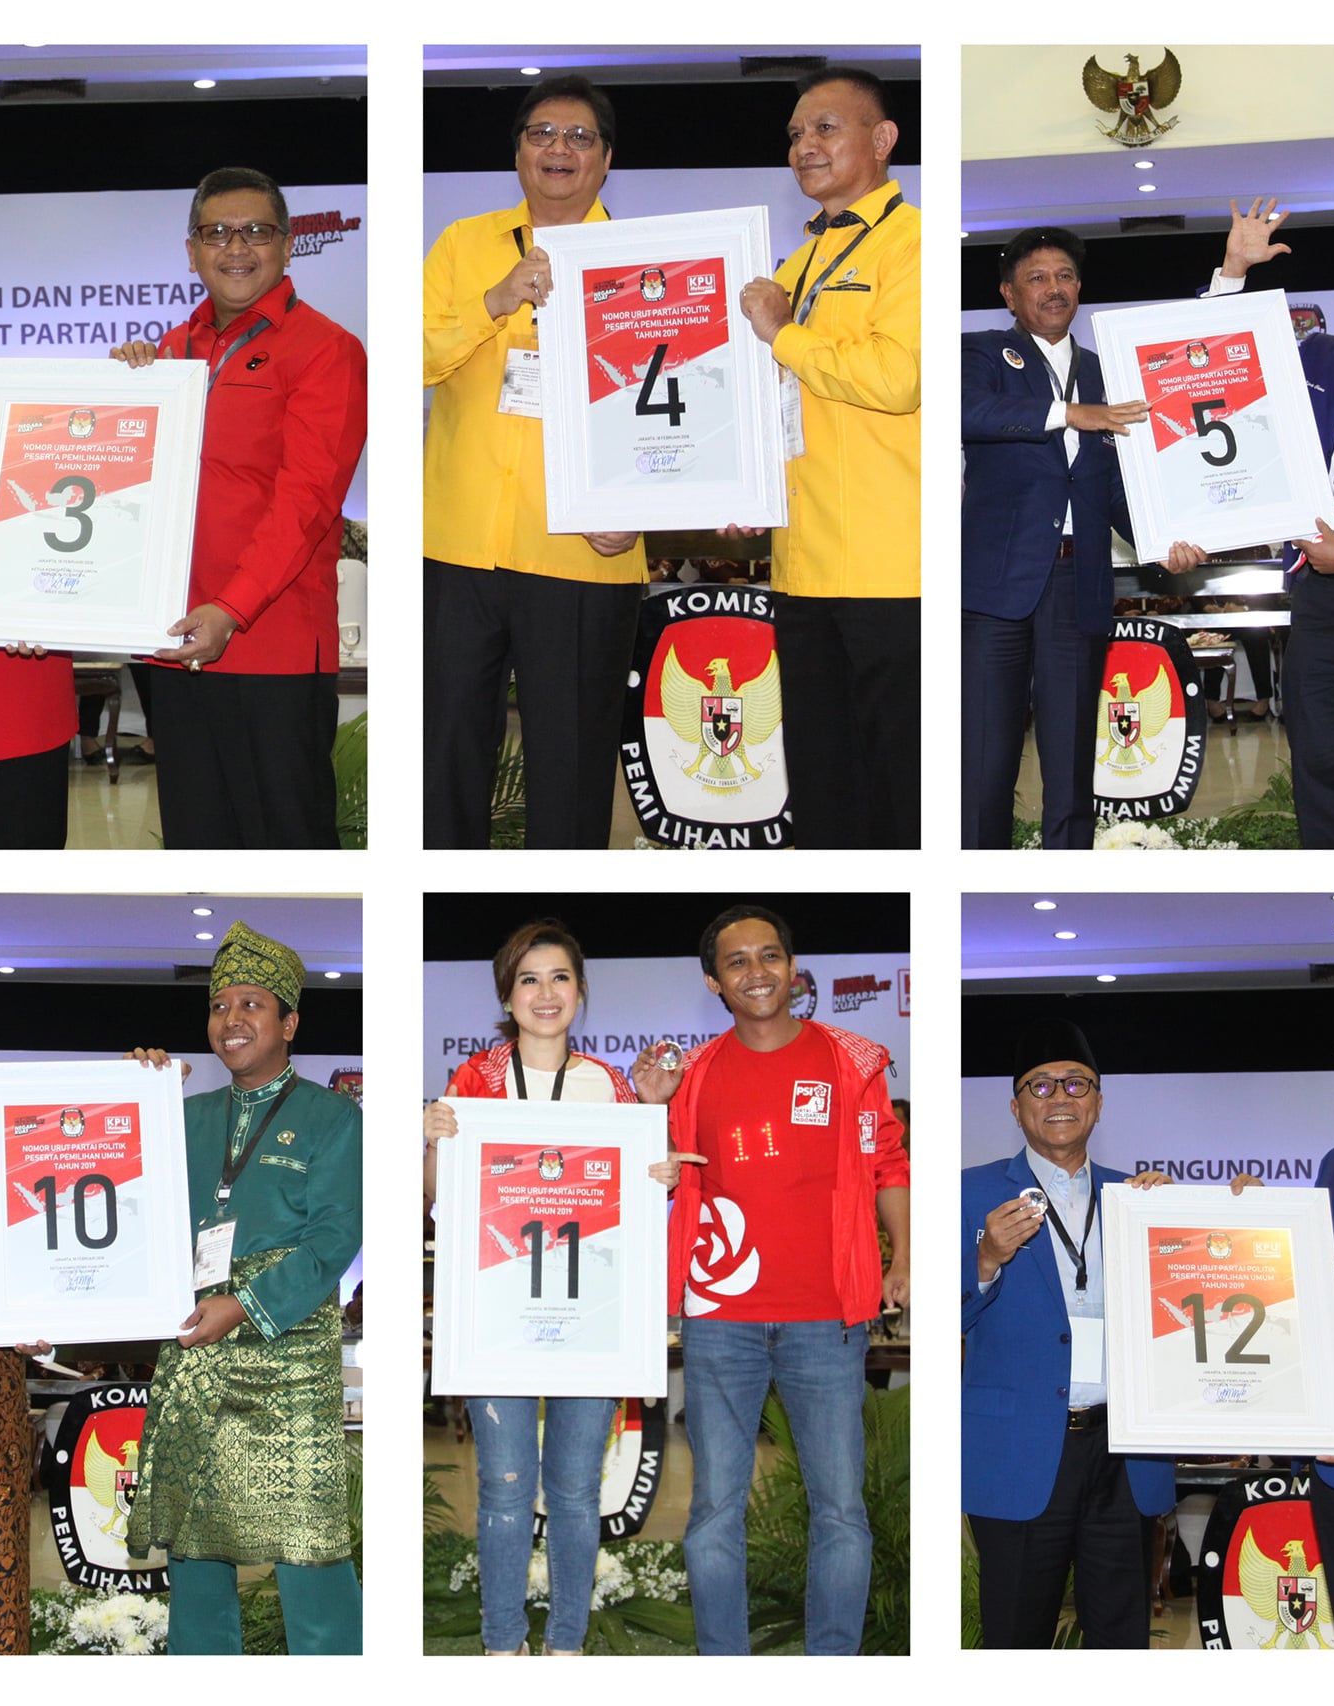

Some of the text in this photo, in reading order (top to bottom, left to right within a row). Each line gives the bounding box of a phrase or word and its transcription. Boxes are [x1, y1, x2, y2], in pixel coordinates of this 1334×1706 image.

[689, 275, 713, 287] KPU
[12, 283, 205, 309] DAN PENETAP
[602, 304, 710, 322] NOMOR URUT PARTAI POLITIK
[605, 315, 708, 331] PESERTA PEMILIHAN UMUM
[21, 322, 116, 345] PARTAI
[634, 328, 678, 339] TAHUN 2019
[636, 344, 685, 426] 4
[119, 420, 144, 429] KPU
[1192, 399, 1237, 466] 5
[44, 476, 96, 552] 3
[1115, 622, 1165, 641] MISI
[1159, 735, 1201, 812] UMUM
[622, 742, 750, 849] PEMILIHAN
[796, 1086, 813, 1096] PSI
[106, 1117, 128, 1126] KPU
[586, 1162, 609, 1171] KPU
[498, 1186, 525, 1194] NOMOR
[548, 1187, 574, 1195] PARTAI
[576, 1188, 604, 1196] POLITIK
[500, 1196, 534, 1204] PESERTA
[535, 1197, 577, 1205] PEMILIHAN
[35, 1174, 117, 1250] 10
[529, 1206, 555, 1214] TAHUN
[521, 1221, 579, 1299] 11
[1182, 1294, 1270, 1364] 12
[91, 1388, 148, 1408] KOM
[609, 1450, 659, 1536] UMUM
[1244, 1477, 1311, 1501] KOM
[52, 1506, 152, 1590] PEMILIHAN
